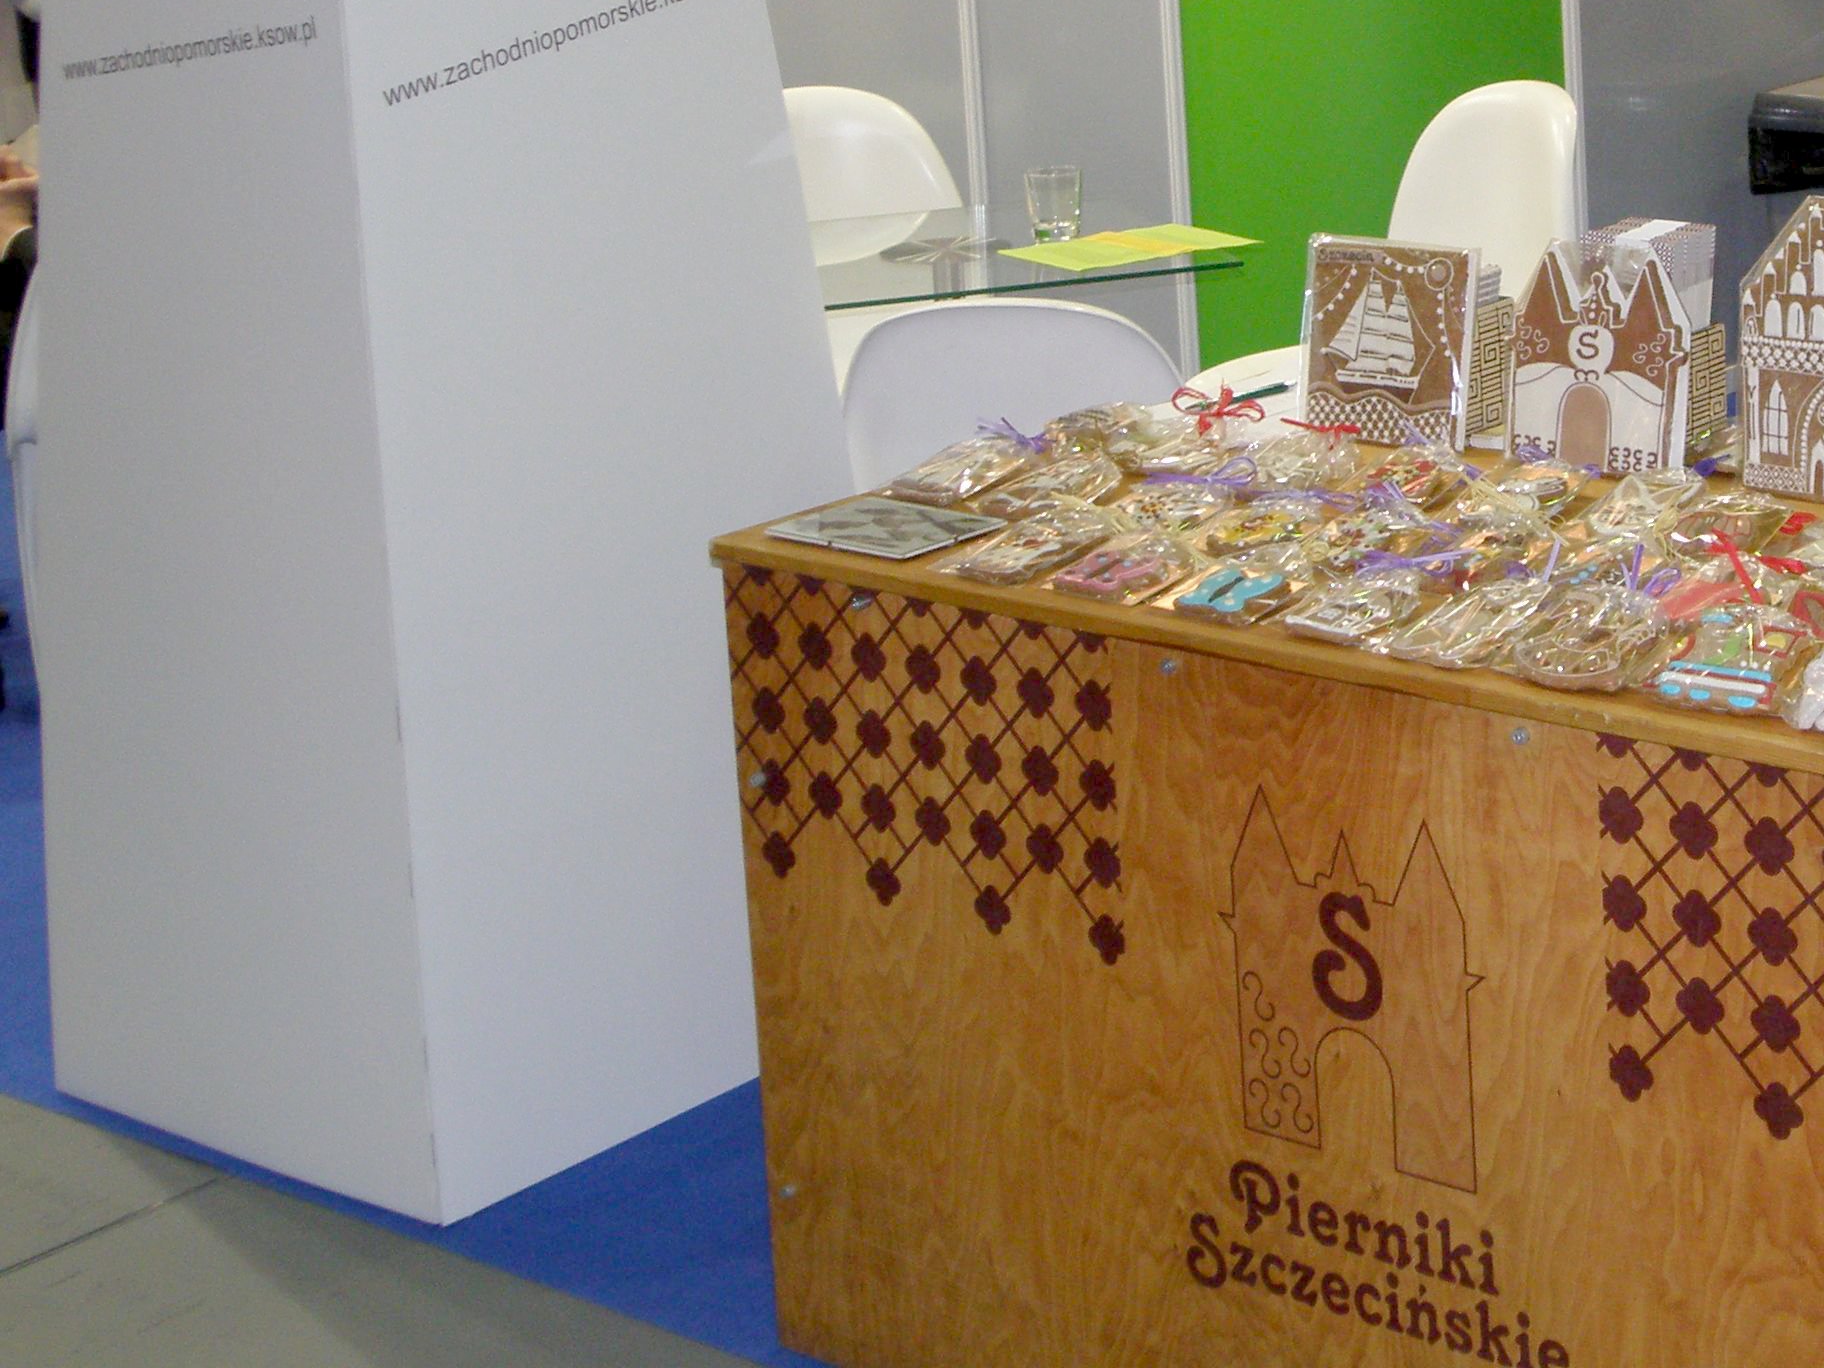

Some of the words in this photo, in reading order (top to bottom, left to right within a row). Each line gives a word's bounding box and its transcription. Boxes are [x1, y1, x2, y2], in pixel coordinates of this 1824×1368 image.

[62, 15, 318, 82] www.zachodniopomorskie.ksow.pl
[1576, 329, 1600, 360] S
[1311, 891, 1384, 1022] S
[1186, 1212, 1570, 1368] Szczecińskie
[1228, 1158, 1500, 1297] Pierniki
